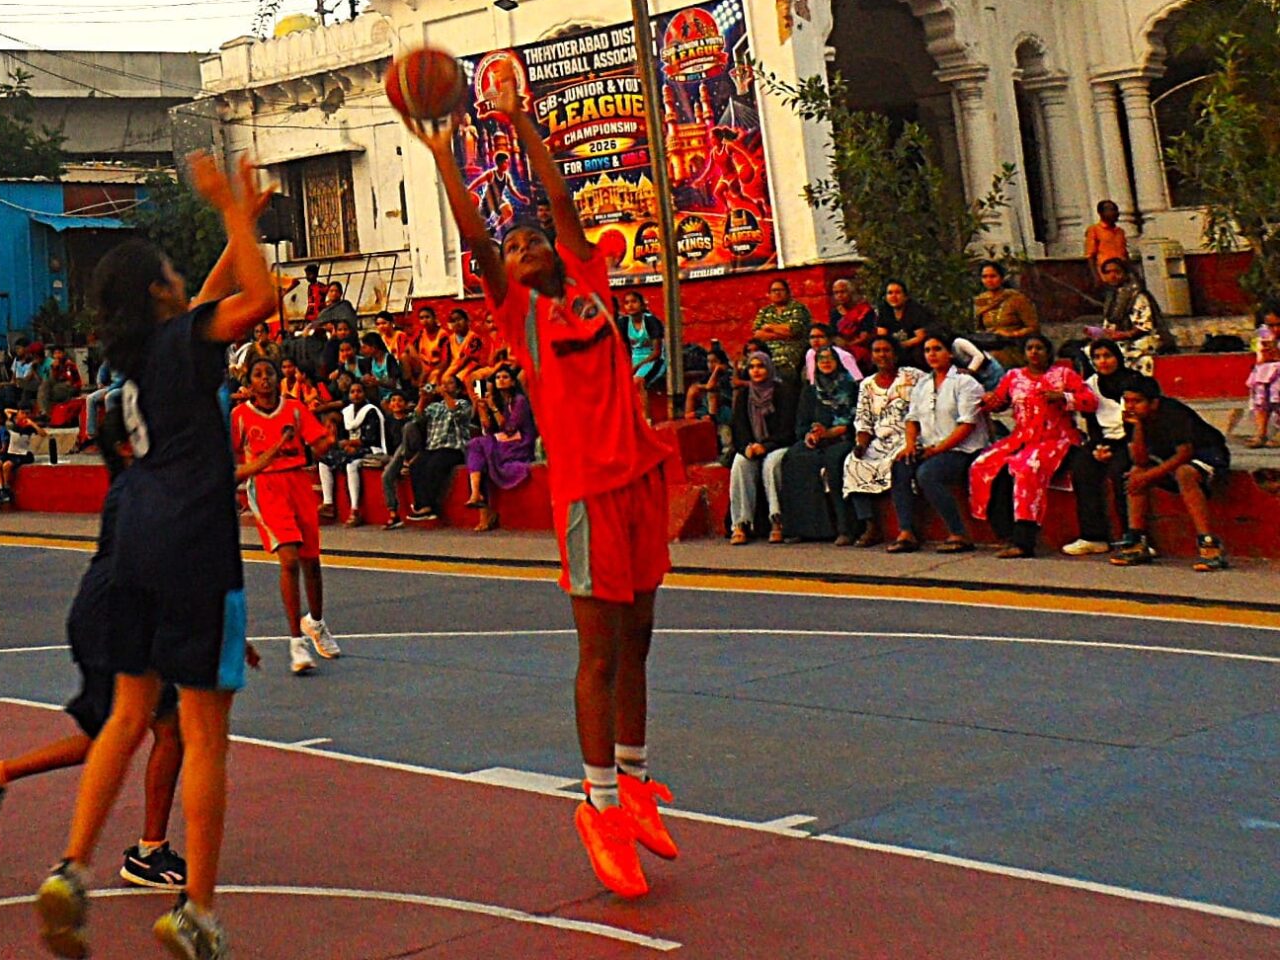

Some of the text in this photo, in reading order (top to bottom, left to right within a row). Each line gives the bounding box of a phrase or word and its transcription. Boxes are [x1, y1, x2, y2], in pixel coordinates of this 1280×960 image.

[671, 45, 719, 64] LEAGUE
[607, 79, 616, 93] &
[549, 94, 644, 134] LEAGUE
[564, 122, 637, 145] CHAMPIONSHIP
[589, 140, 617, 153] 2026
[563, 160, 582, 175] FOR
[584, 157, 611, 171] BOYS
[612, 155, 620, 167] &
[677, 237, 712, 254] KINGS
